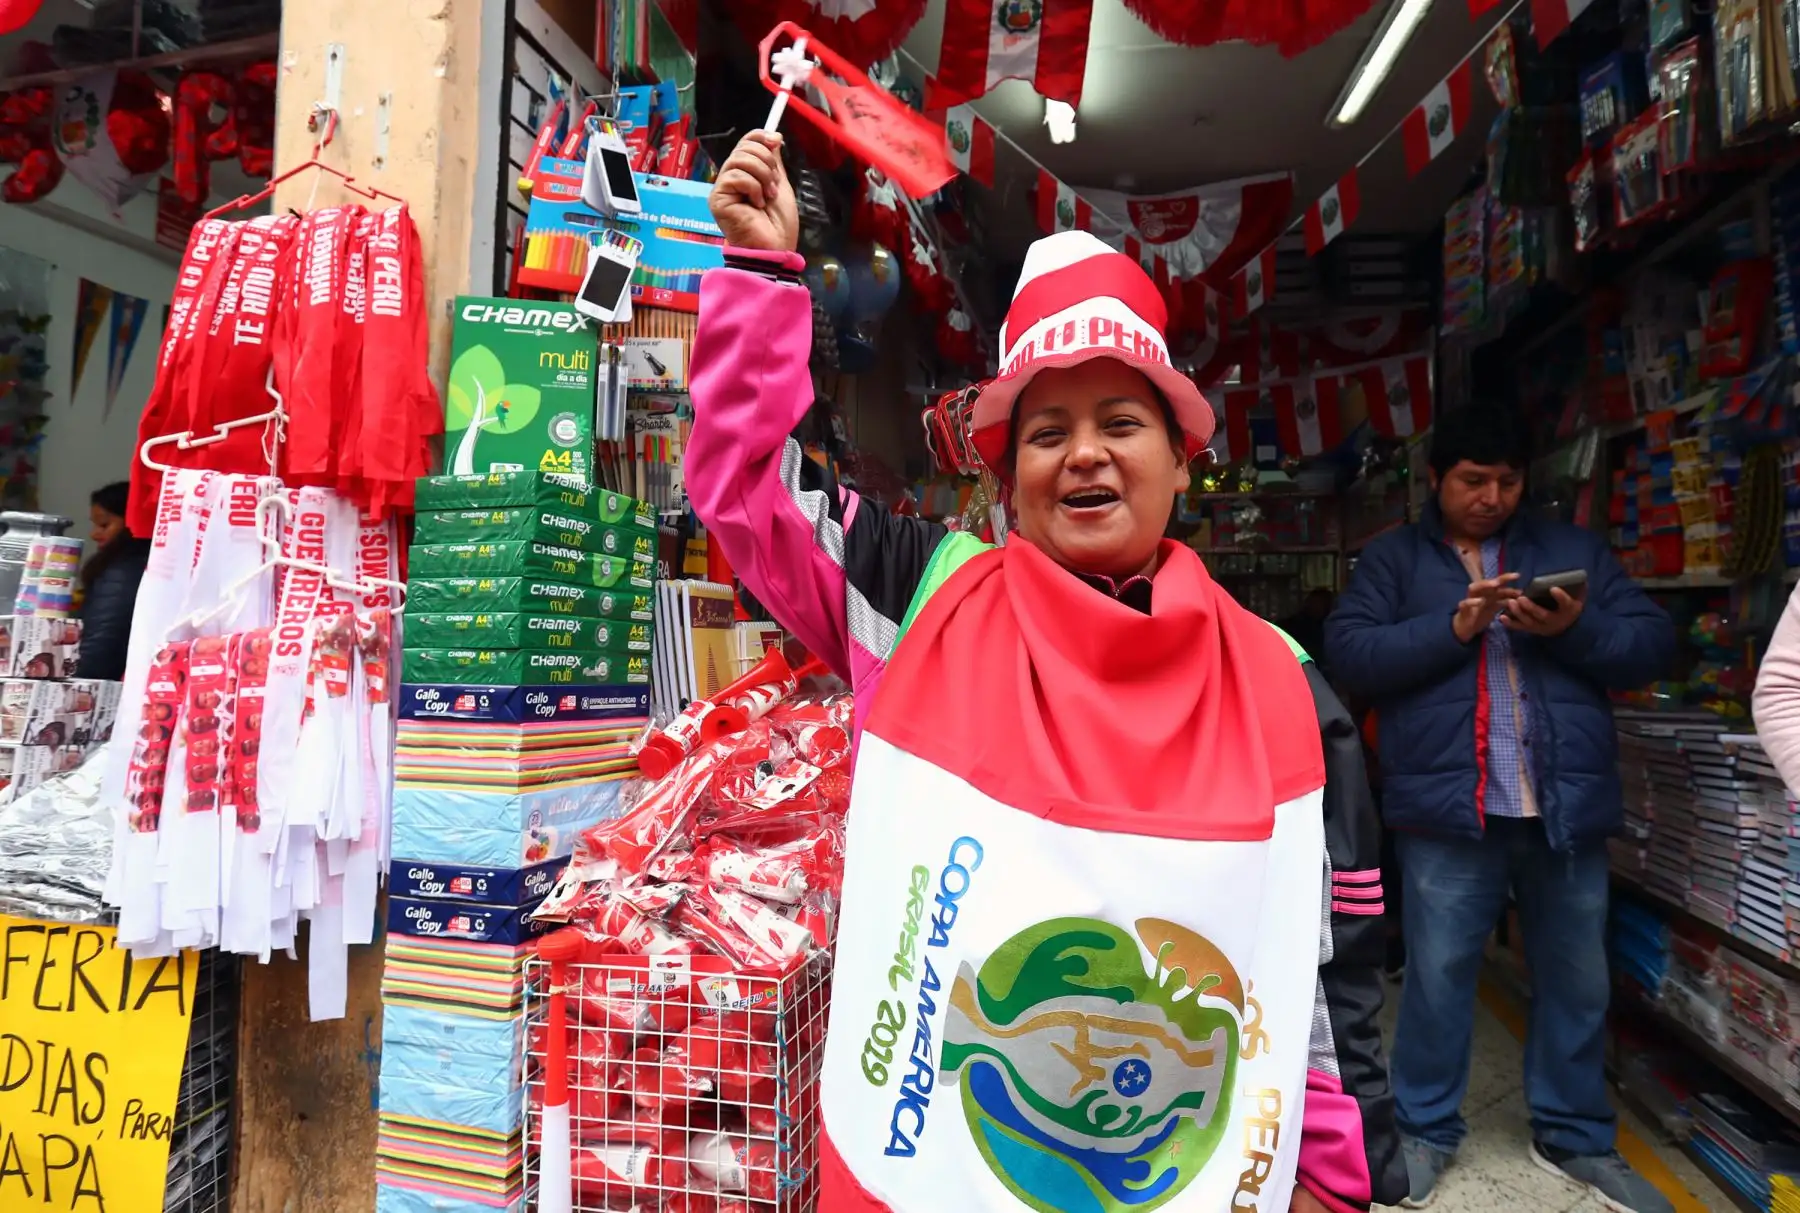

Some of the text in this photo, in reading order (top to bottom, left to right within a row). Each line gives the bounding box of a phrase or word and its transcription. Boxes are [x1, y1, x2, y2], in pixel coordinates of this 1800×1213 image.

[371, 256, 402, 317] PERU
[233, 318, 265, 346] TE
[539, 349, 590, 371] multi
[540, 449, 572, 467] A4
[415, 688, 440, 700] Gallo
[526, 692, 549, 704] Gallo
[425, 700, 450, 713] Copy
[535, 704, 556, 717] Copy
[408, 868, 435, 880] Gallo
[419, 879, 446, 894] Copy
[405, 906, 432, 920] Gallo
[416, 919, 442, 933] Copy
[860, 864, 930, 1087] BRASIL 2019
[883, 836, 984, 1158] COPA AMERICA
[0, 1033, 172, 1142] DIAS PARA
[0, 1128, 107, 1213] APÁ
